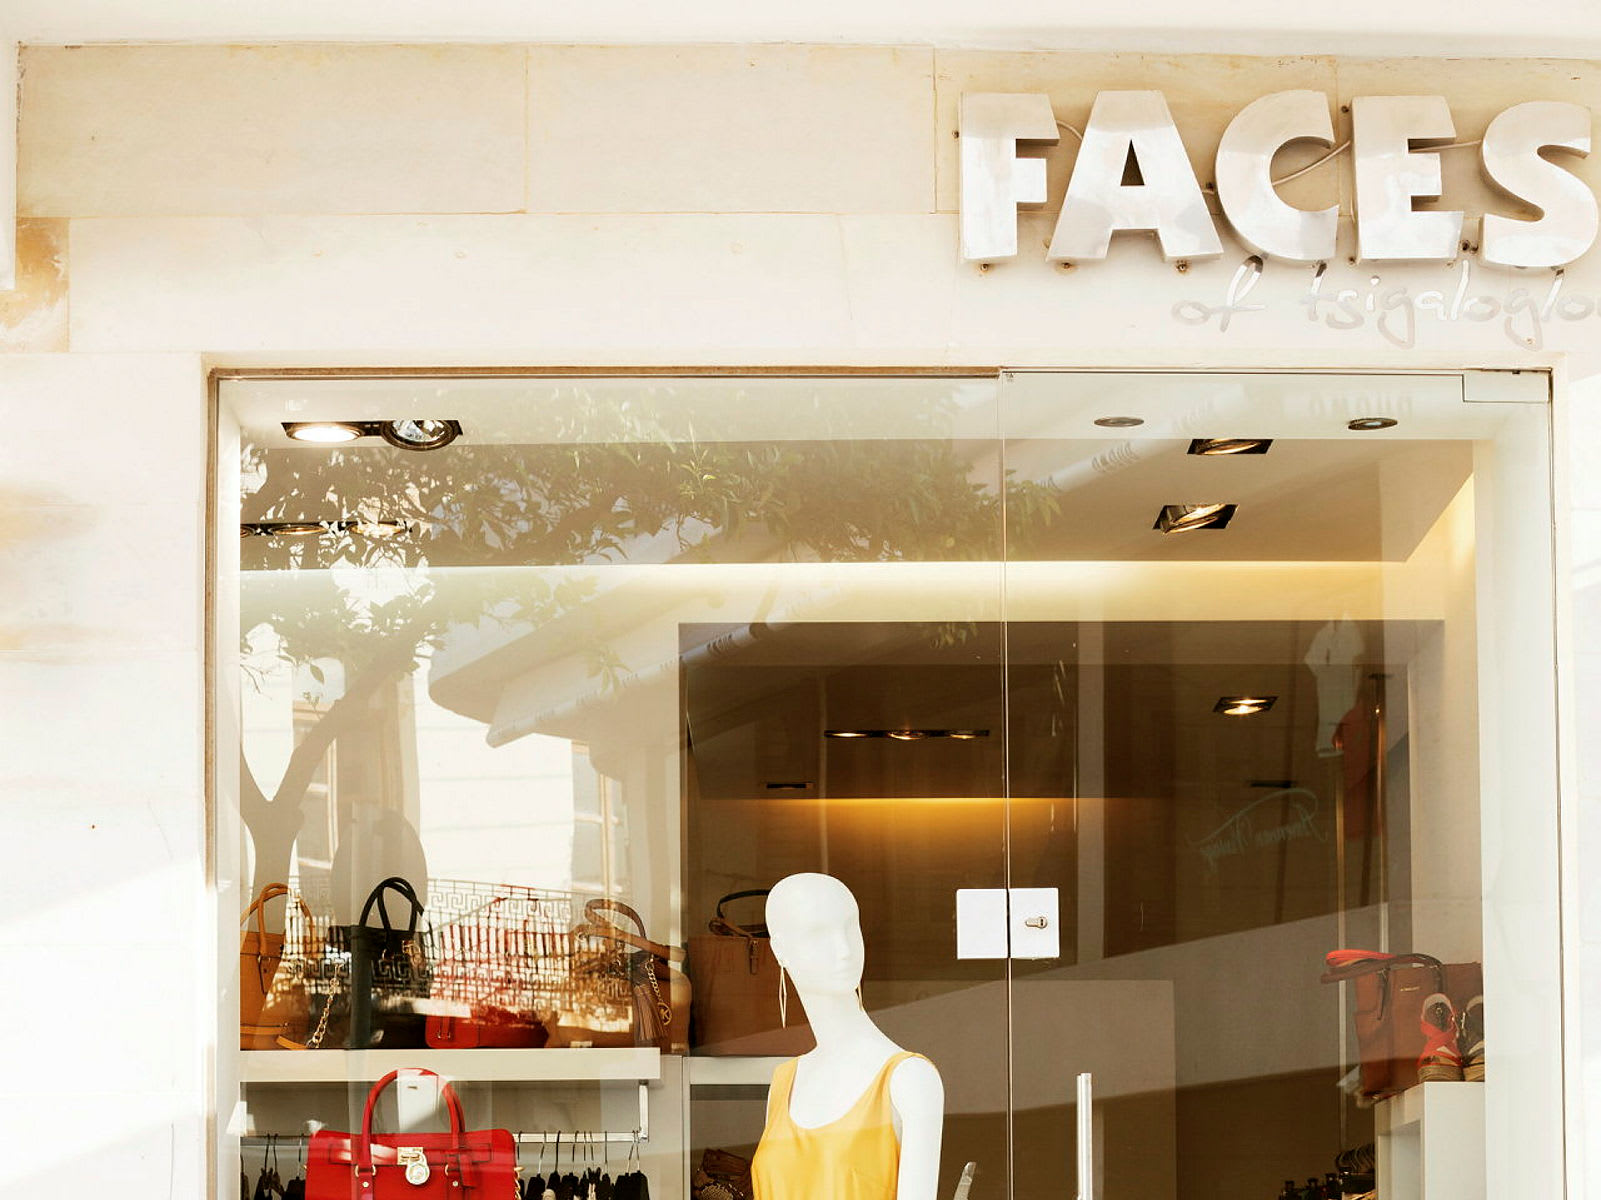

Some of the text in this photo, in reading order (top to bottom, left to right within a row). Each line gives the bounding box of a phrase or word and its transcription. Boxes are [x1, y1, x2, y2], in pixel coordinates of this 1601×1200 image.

[958, 89, 1599, 269] FACES
[1170, 255, 1601, 351] of tsigaloglo
